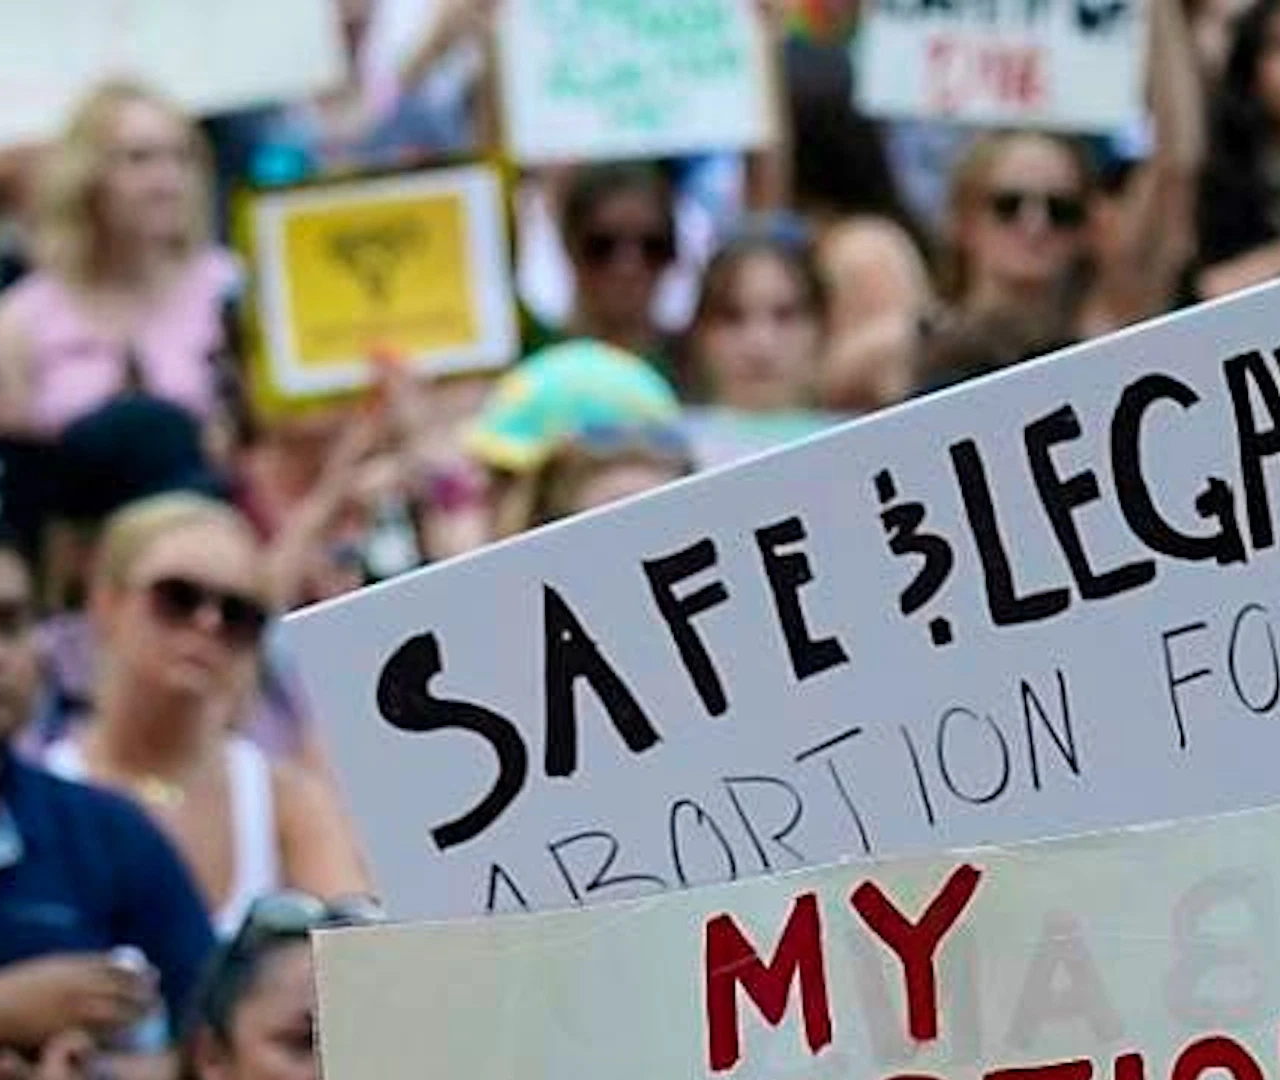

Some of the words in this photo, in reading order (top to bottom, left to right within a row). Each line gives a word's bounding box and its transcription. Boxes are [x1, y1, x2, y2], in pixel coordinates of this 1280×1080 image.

[375, 515, 850, 851] SAFE
[873, 467, 954, 646] &
[704, 863, 983, 1072] MY
